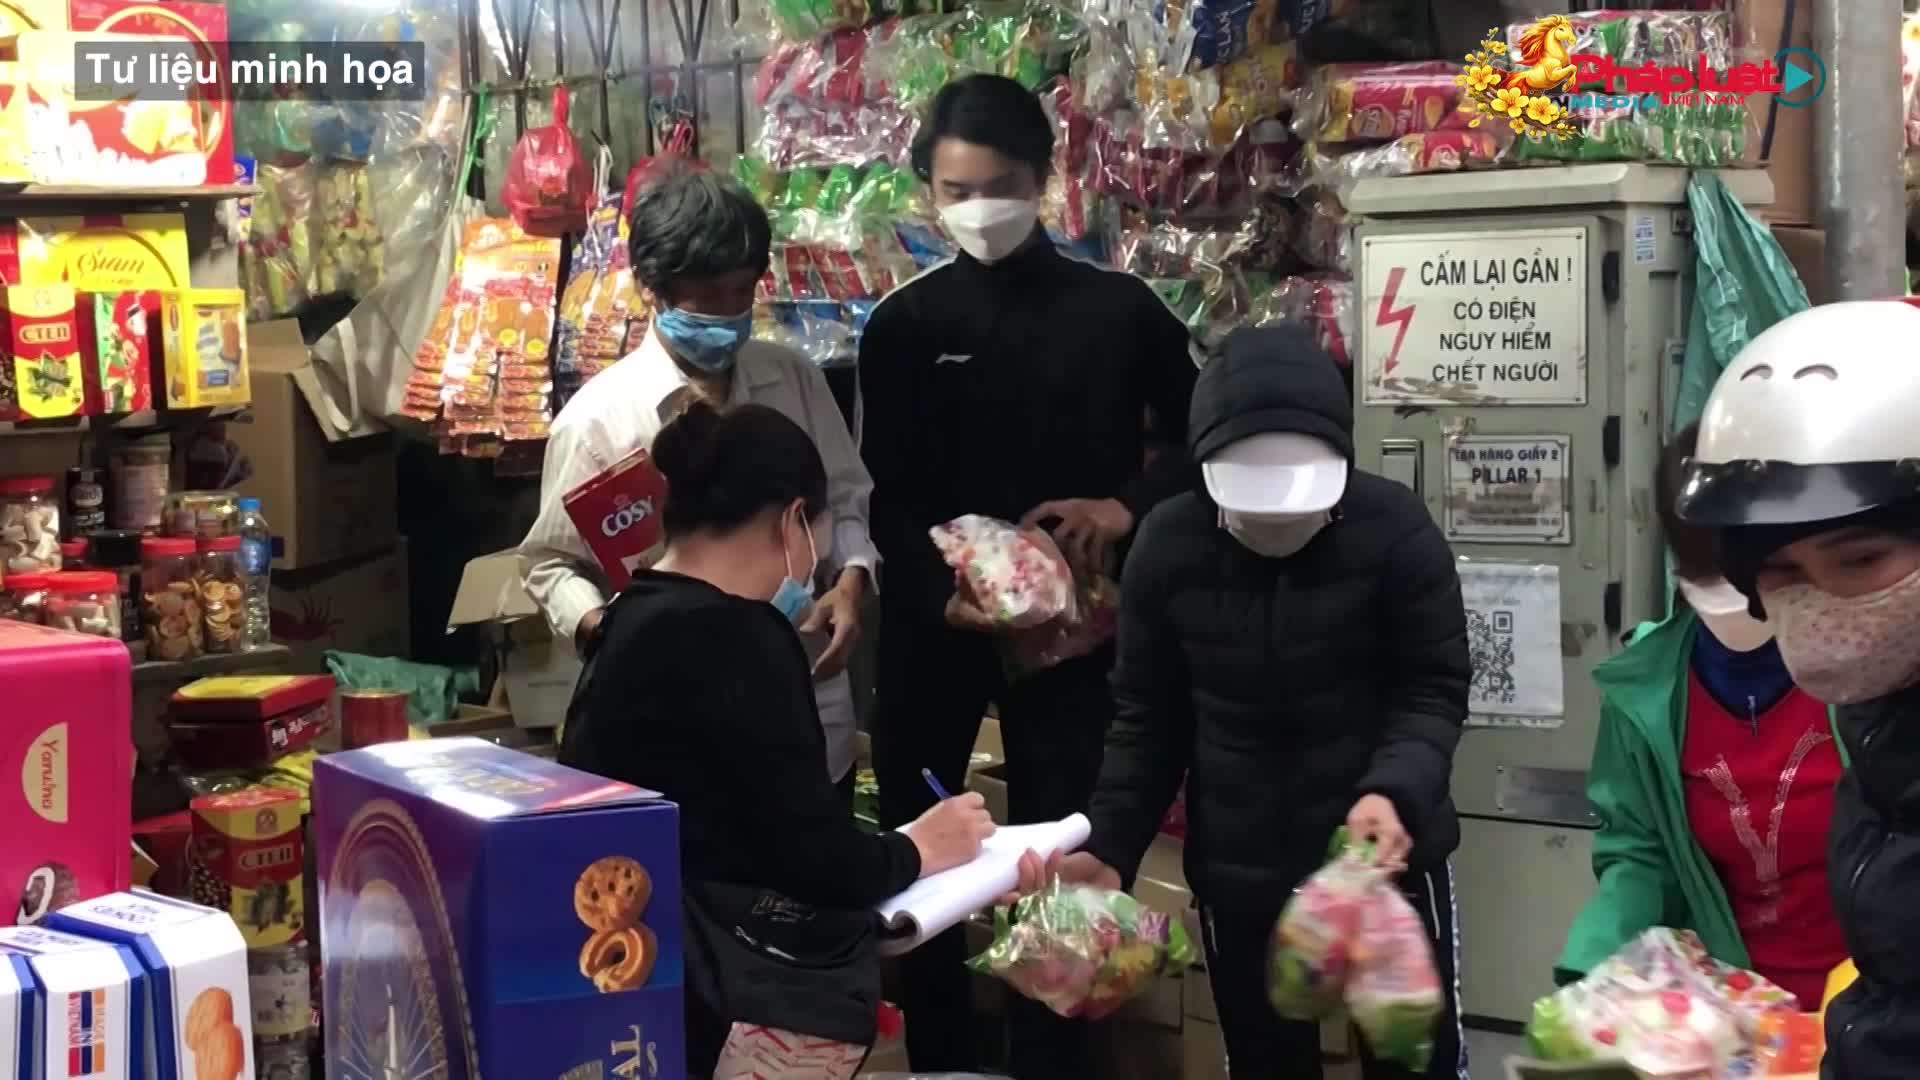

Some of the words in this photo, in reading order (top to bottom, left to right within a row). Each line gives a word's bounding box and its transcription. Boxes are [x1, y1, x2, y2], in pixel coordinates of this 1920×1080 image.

[1420, 249, 1466, 286] CẤM
[1473, 259, 1506, 291] LẠI
[1512, 247, 1560, 284] GẦN
[1453, 297, 1483, 320] CÓ
[1489, 296, 1536, 324] ĐIỆN
[1439, 331, 1496, 351] NGUY
[1501, 322, 1551, 350] HIỂM
[1432, 355, 1487, 382] CHẾT
[1493, 359, 1558, 382] NGƯỜI
